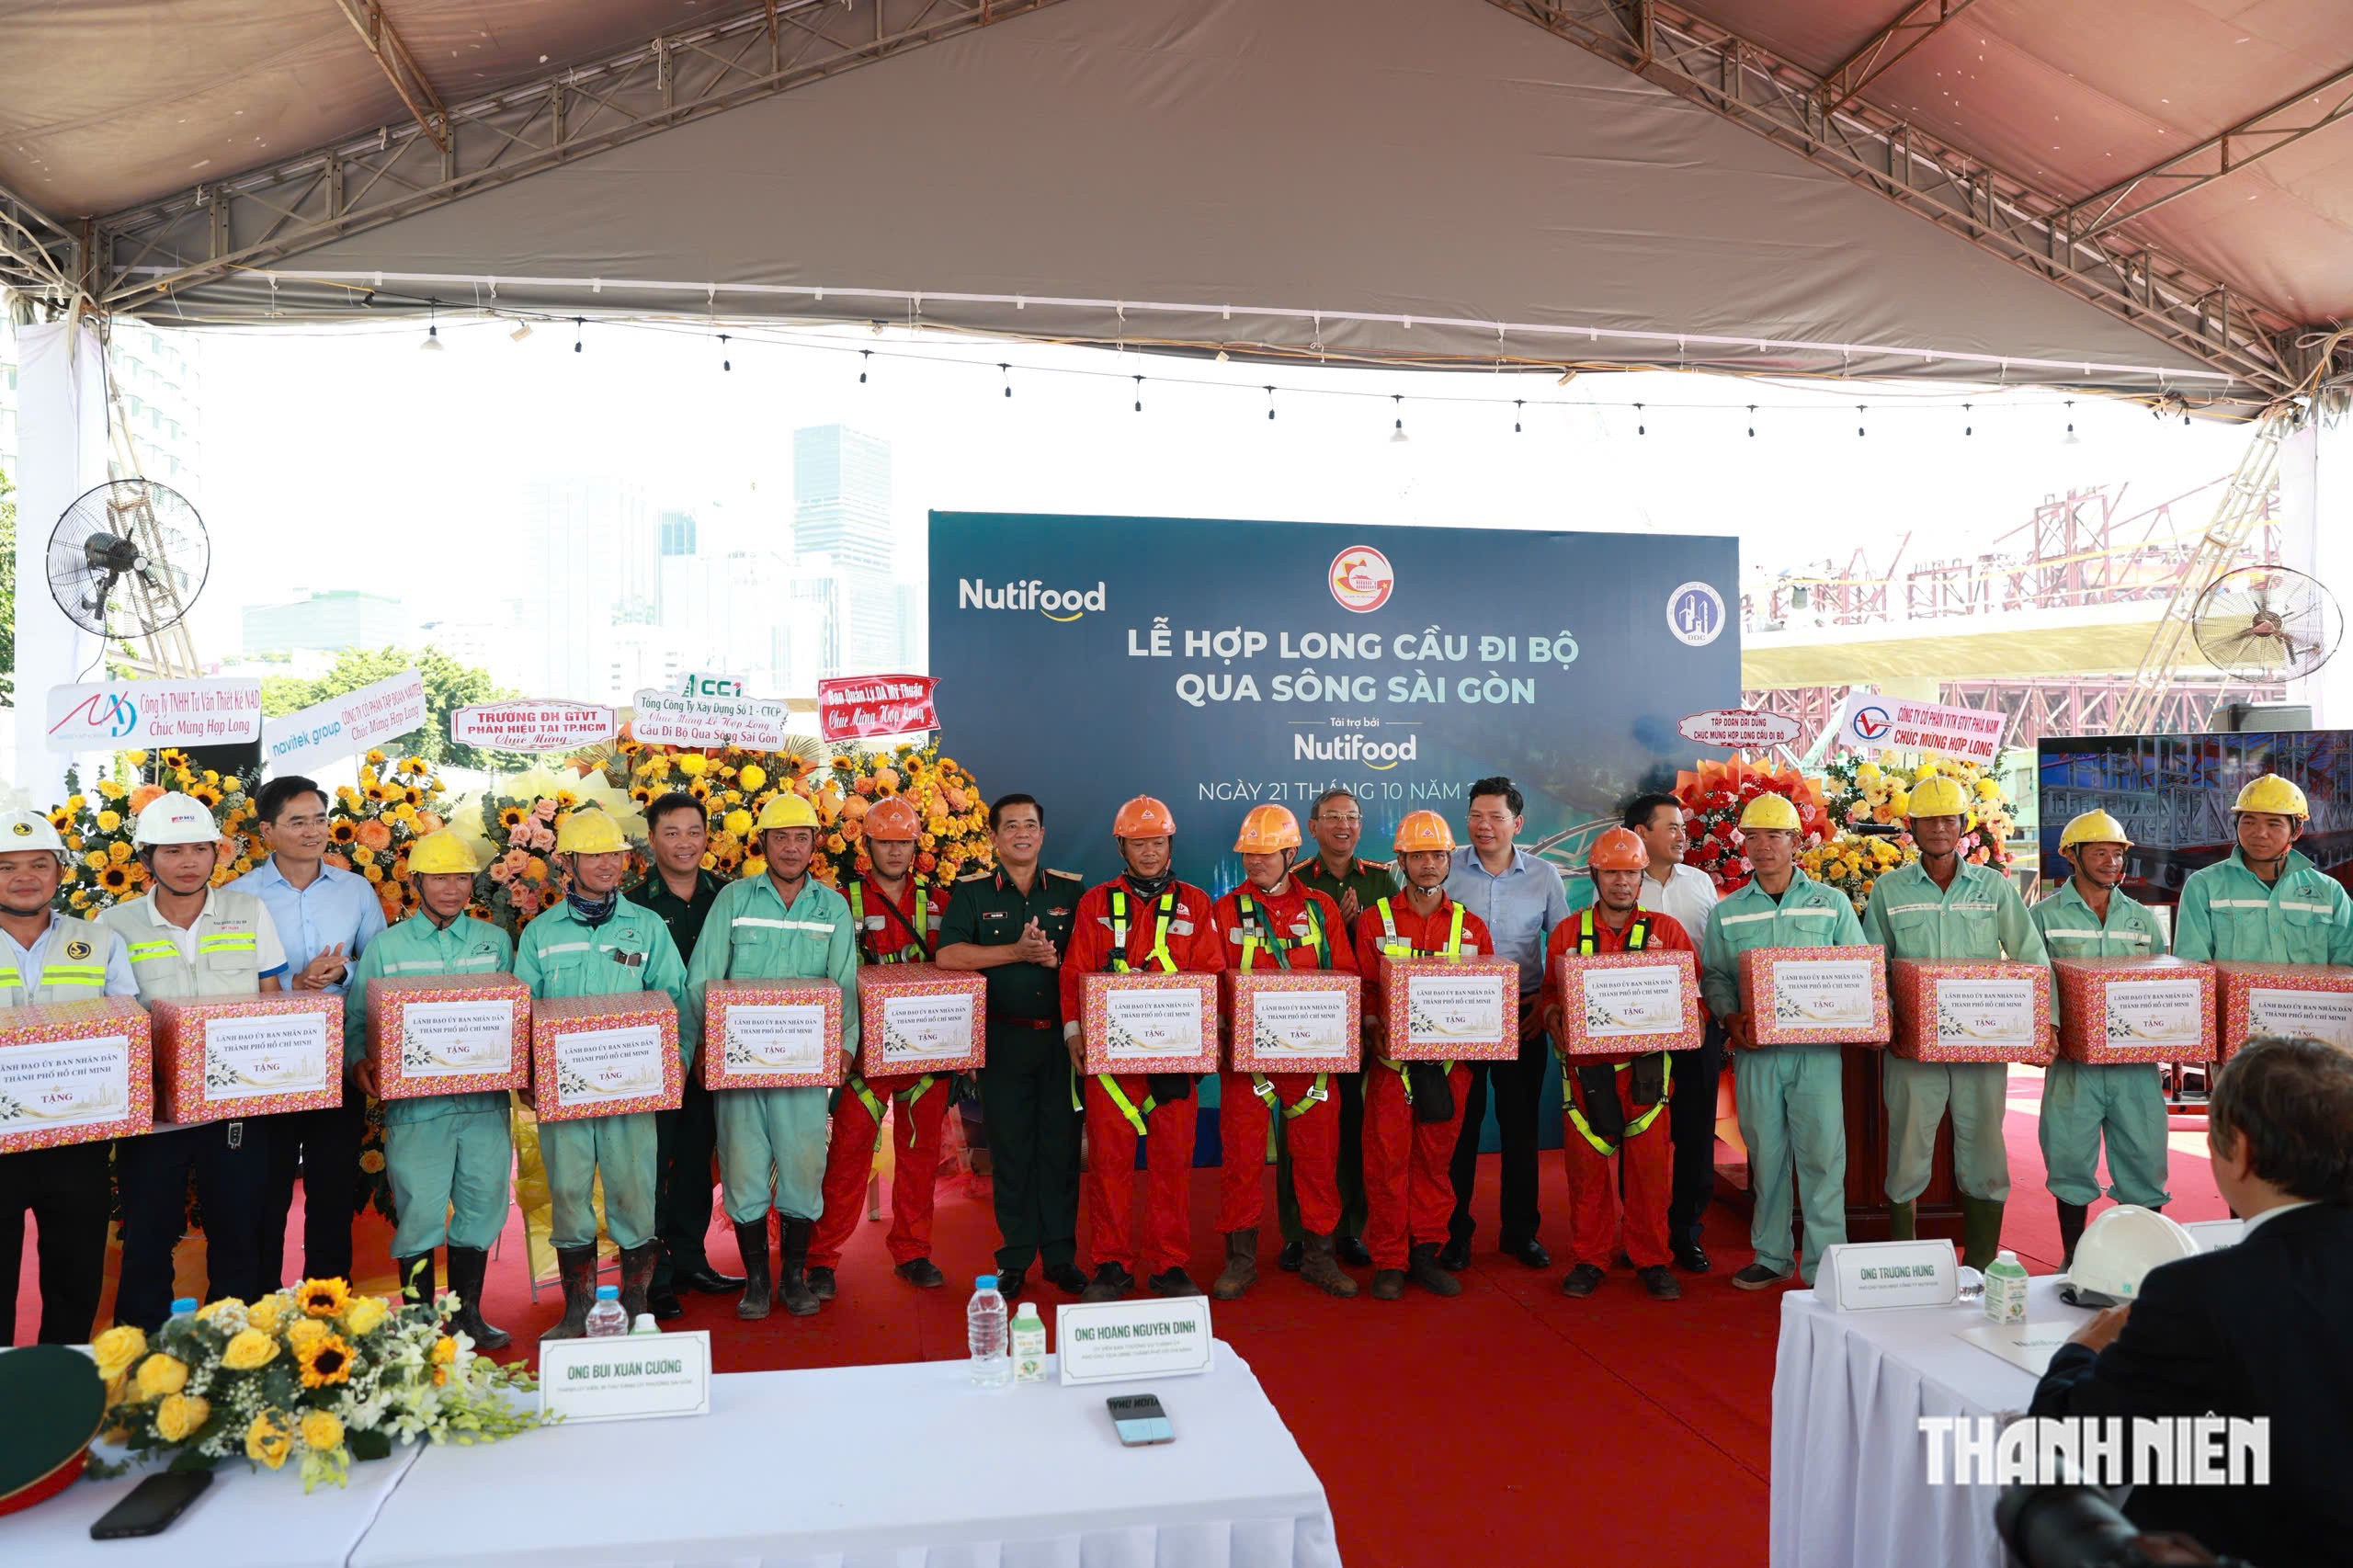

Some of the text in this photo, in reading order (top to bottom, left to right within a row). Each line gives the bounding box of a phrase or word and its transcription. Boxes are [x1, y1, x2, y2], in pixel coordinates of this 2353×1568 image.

[959, 578, 1106, 612] Nutifood
[1128, 617, 1579, 671] LỄ HỢP LONG CẦU ĐI BỘ
[1176, 667, 1535, 707] QUA SÔNG SÀI GÒN
[161, 693, 168, 716] Ty
[169, 691, 188, 714] TNHH
[245, 689, 260, 710] NAD
[828, 689, 845, 706] Ban
[540, 711, 561, 722] ĐH
[564, 710, 598, 722] GTVT
[687, 699, 695, 714] Ty
[749, 705, 754, 716] 1
[761, 706, 781, 717] CTCP
[150, 720, 174, 736] Chúc
[228, 718, 250, 735] Long
[563, 723, 607, 733] TP.HCM
[1329, 716, 1381, 729] Tài trợ bởi
[1985, 719, 2000, 734] NAM
[272, 721, 342, 756] navitek group
[691, 727, 710, 740] Qua
[1894, 728, 1917, 746] CHÚC
[1968, 740, 1994, 757] LONG
[1294, 733, 1417, 761] Nutifood
[1199, 779, 1263, 801] NGÀY
[1268, 782, 1288, 801] 21
[1381, 782, 1404, 800] 10
[1410, 779, 1461, 800] NĂM
